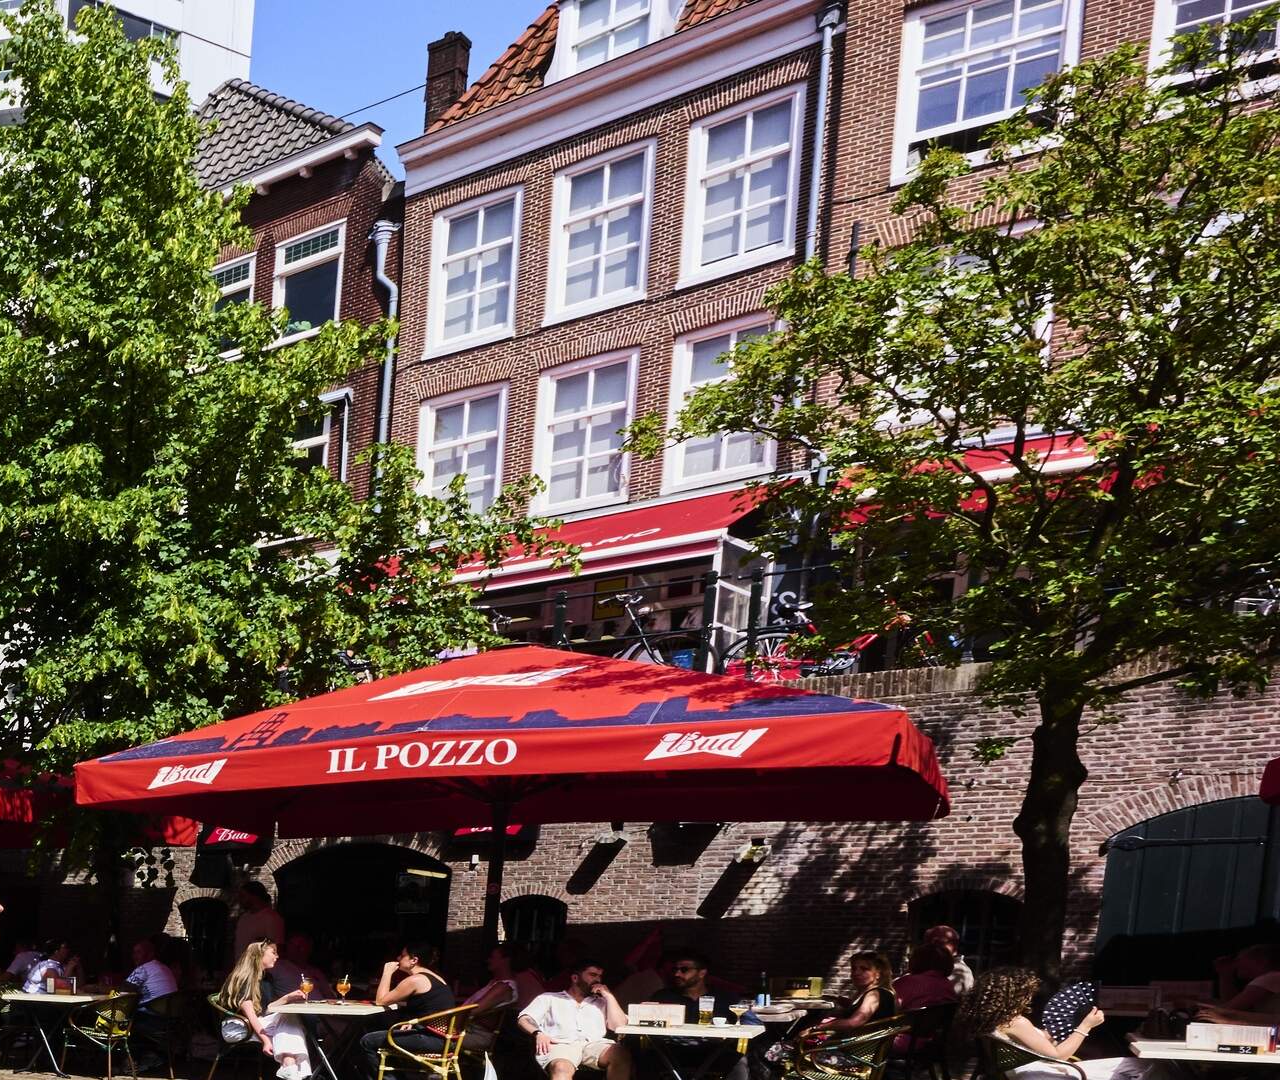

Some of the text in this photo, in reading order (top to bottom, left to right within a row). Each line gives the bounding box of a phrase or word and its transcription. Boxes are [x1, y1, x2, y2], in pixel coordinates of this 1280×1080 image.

[326, 738, 518, 774] IL POZZO
[656, 728, 755, 756] Bud
[155, 760, 220, 784] Bud
